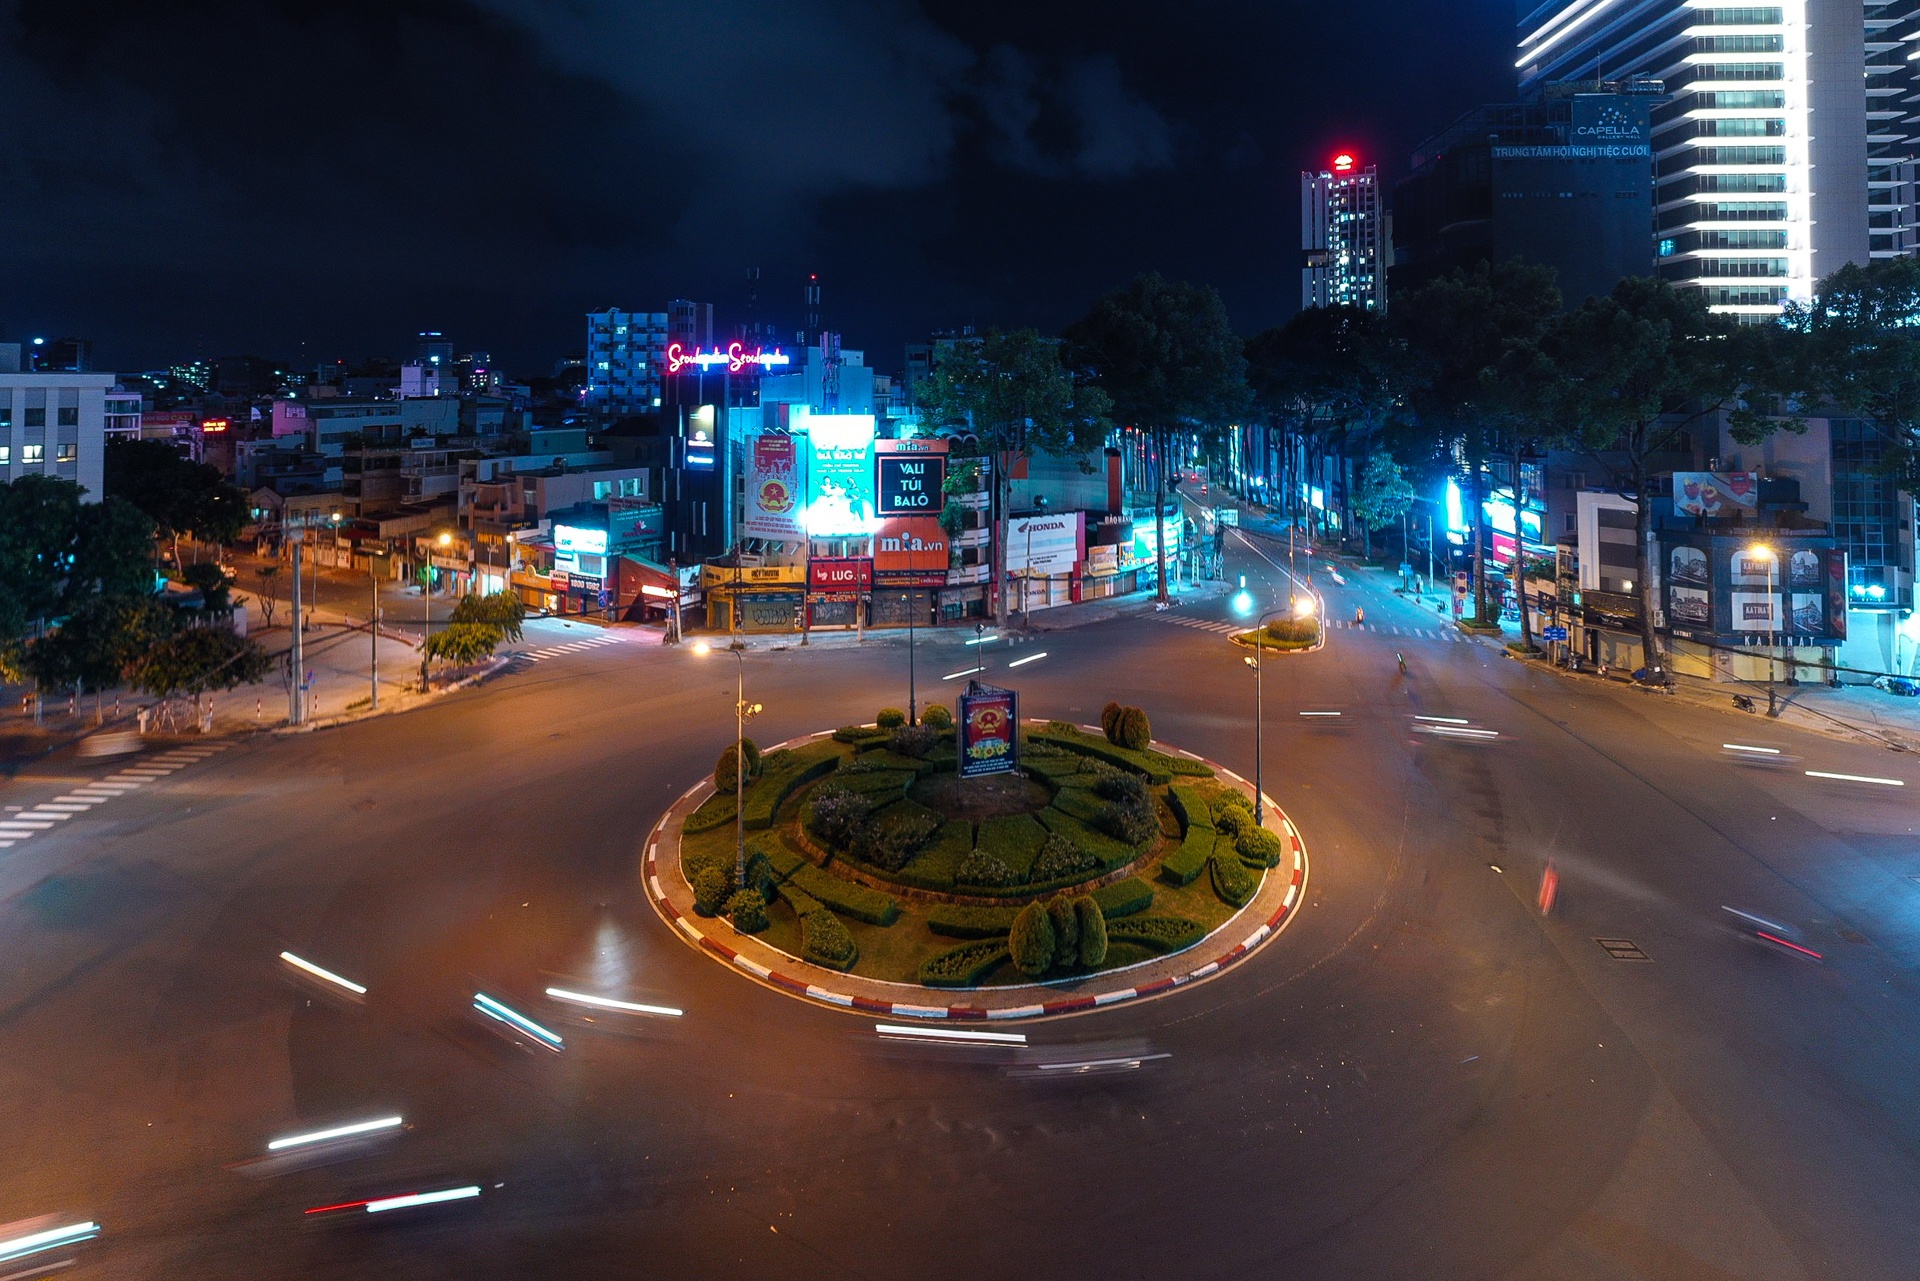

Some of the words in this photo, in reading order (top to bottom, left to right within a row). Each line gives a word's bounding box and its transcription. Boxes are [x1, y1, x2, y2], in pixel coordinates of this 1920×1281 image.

[1577, 126, 1640, 135] CAPELLA
[1496, 147, 1529, 157] TRUNG
[1531, 146, 1551, 157] TÂM
[1553, 145, 1571, 159] HỘI
[1572, 147, 1597, 159] NGHỊ
[1599, 145, 1621, 159] TIỆC
[896, 441, 930, 451] mia.vn
[900, 463, 925, 474] VALI
[900, 477, 922, 491] TÚI
[894, 492, 929, 507] BALÔ
[1029, 521, 1066, 532] HONDA
[880, 532, 943, 552] mia.vn
[831, 570, 867, 581] LUG.n
